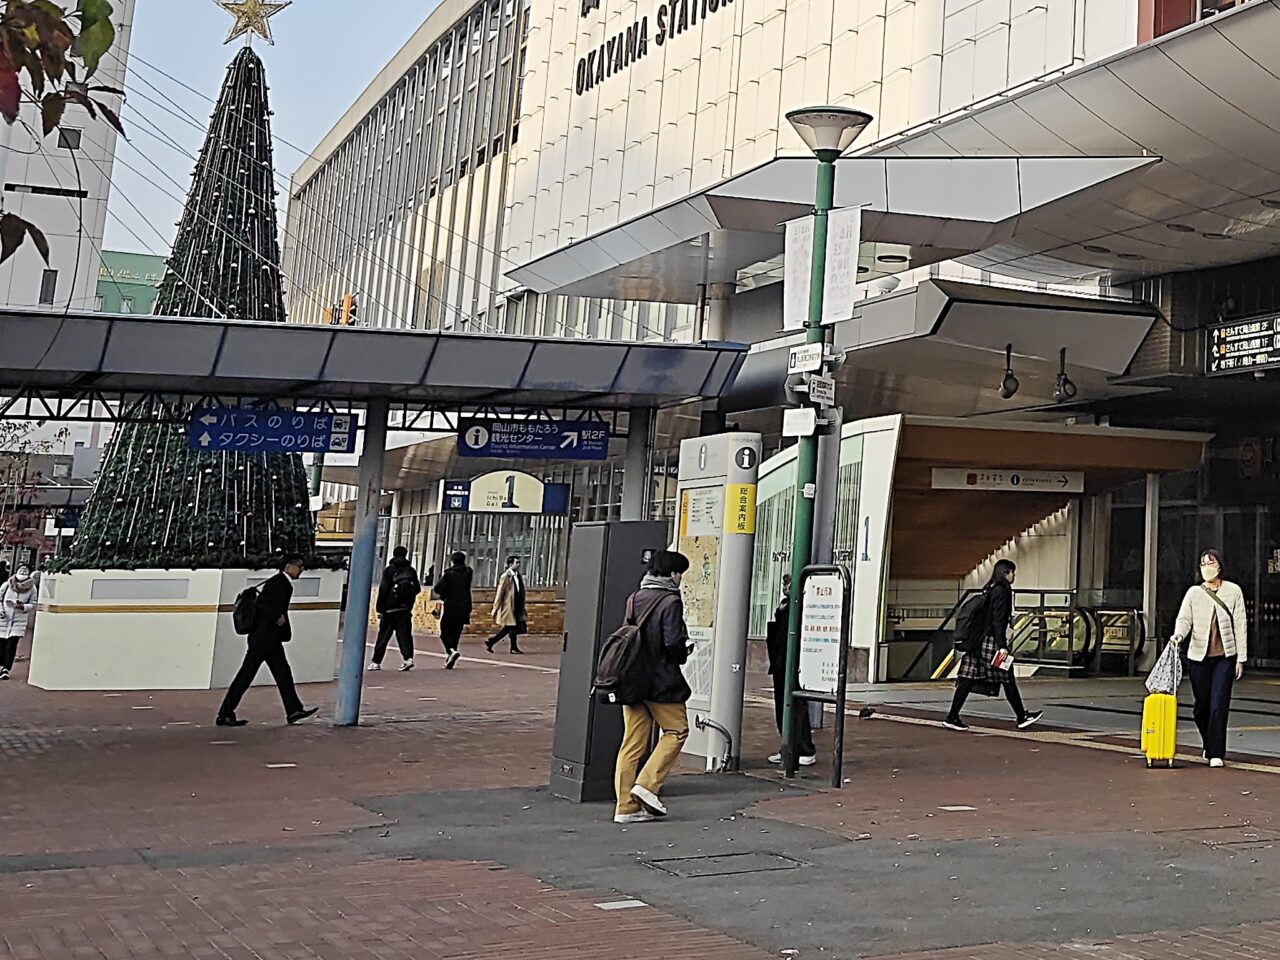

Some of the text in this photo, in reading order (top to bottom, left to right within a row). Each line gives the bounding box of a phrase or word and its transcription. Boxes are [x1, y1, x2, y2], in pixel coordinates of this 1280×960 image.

[576, 16, 647, 96] OKAYAMA
[220, 414, 329, 430] バスのりば
[492, 422, 558, 434] 岡山市ももたろう
[218, 433, 325, 448] タクシーのりば
[491, 433, 543, 443] 観光センター
[581, 430, 605, 440] 駅2F
[502, 475, 519, 508] 1
[737, 487, 748, 530] 総合案内板
